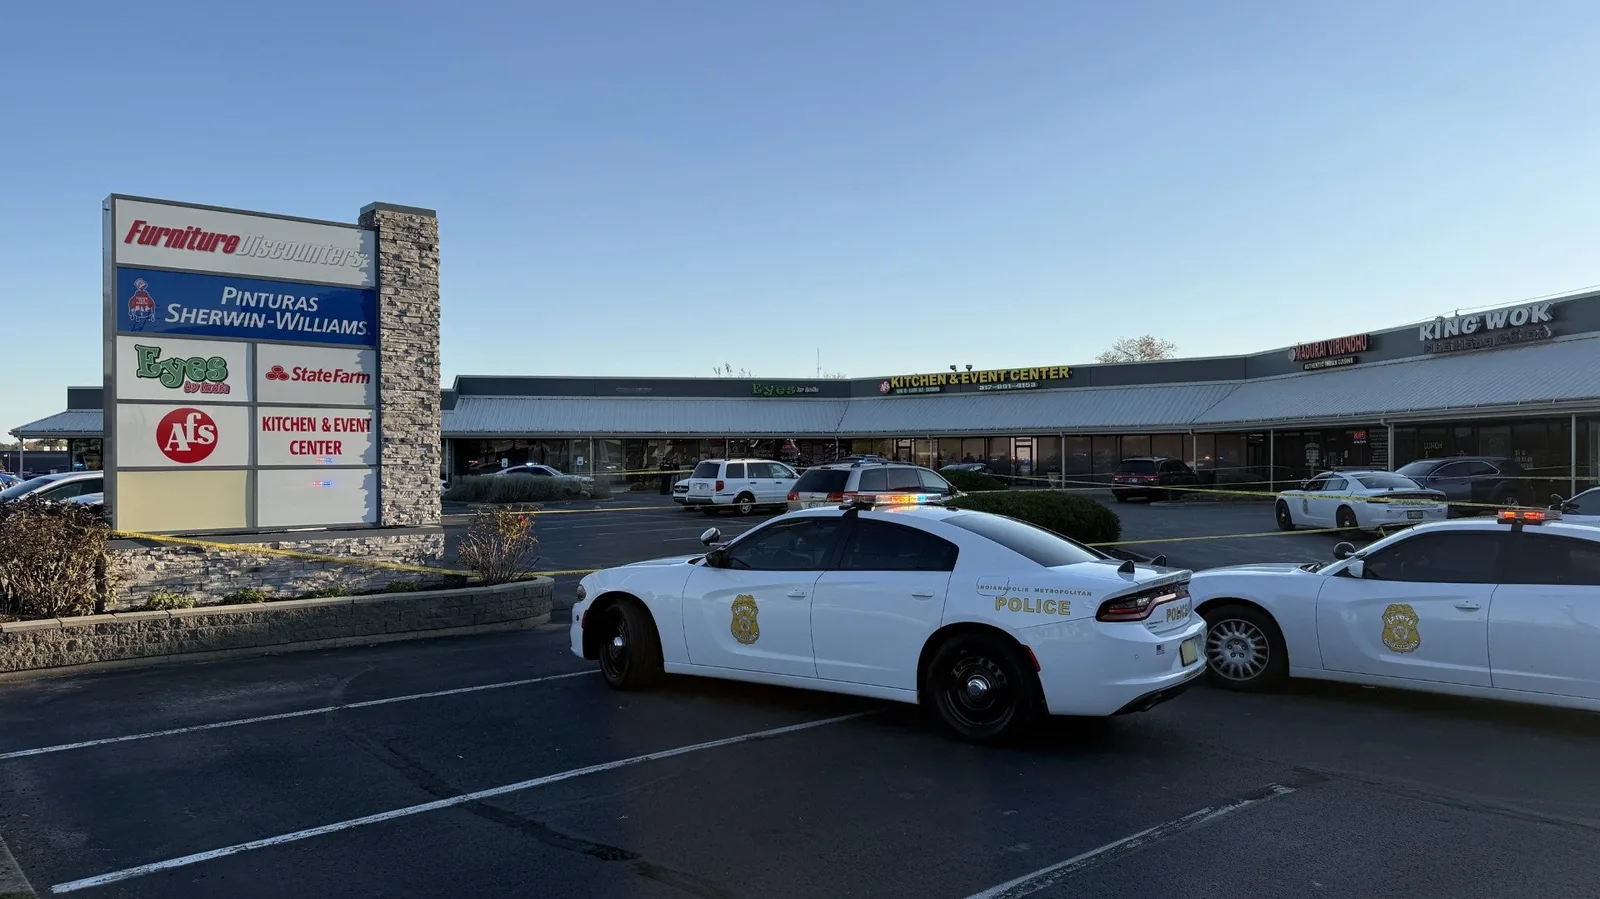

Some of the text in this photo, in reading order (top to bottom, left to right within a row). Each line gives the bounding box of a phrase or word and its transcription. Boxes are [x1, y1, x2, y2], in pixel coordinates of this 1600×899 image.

[221, 286, 318, 312] PINTURAS
[1419, 303, 1553, 341] KING WOK
[1327, 334, 1367, 356] VIRUNDHU
[134, 344, 228, 388] Eyes
[184, 381, 200, 393] by
[891, 366, 1070, 388] KITCHEN & EVENT CENTER
[752, 383, 796, 396] Eyes
[262, 416, 372, 433] KITCHEN & EVENT
[289, 440, 342, 456] CENTER
[977, 585, 1092, 597] INDIANAPOLIS METROPOLITAN
[995, 596, 1071, 616] POLICE
